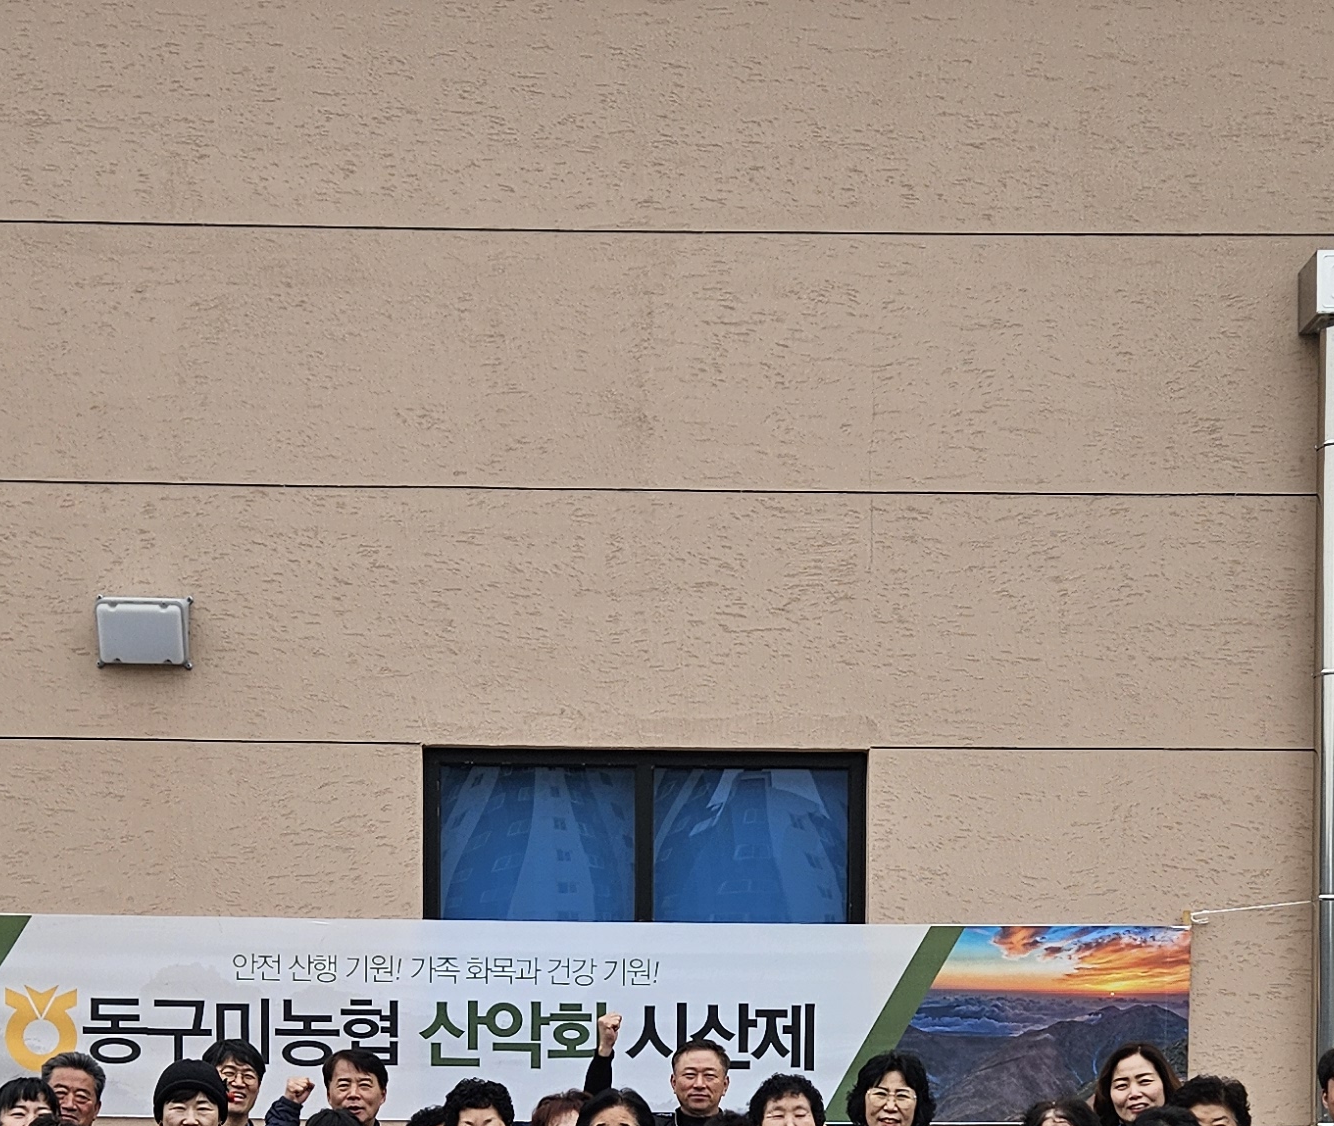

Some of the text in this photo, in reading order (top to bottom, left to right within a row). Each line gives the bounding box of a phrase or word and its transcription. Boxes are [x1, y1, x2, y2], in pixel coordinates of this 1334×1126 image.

[232, 953, 660, 987] 안전 산행 기원! 가족 화목과 건강 기원!
[82, 998, 816, 1071] 동구미농협 산악회 시산제
